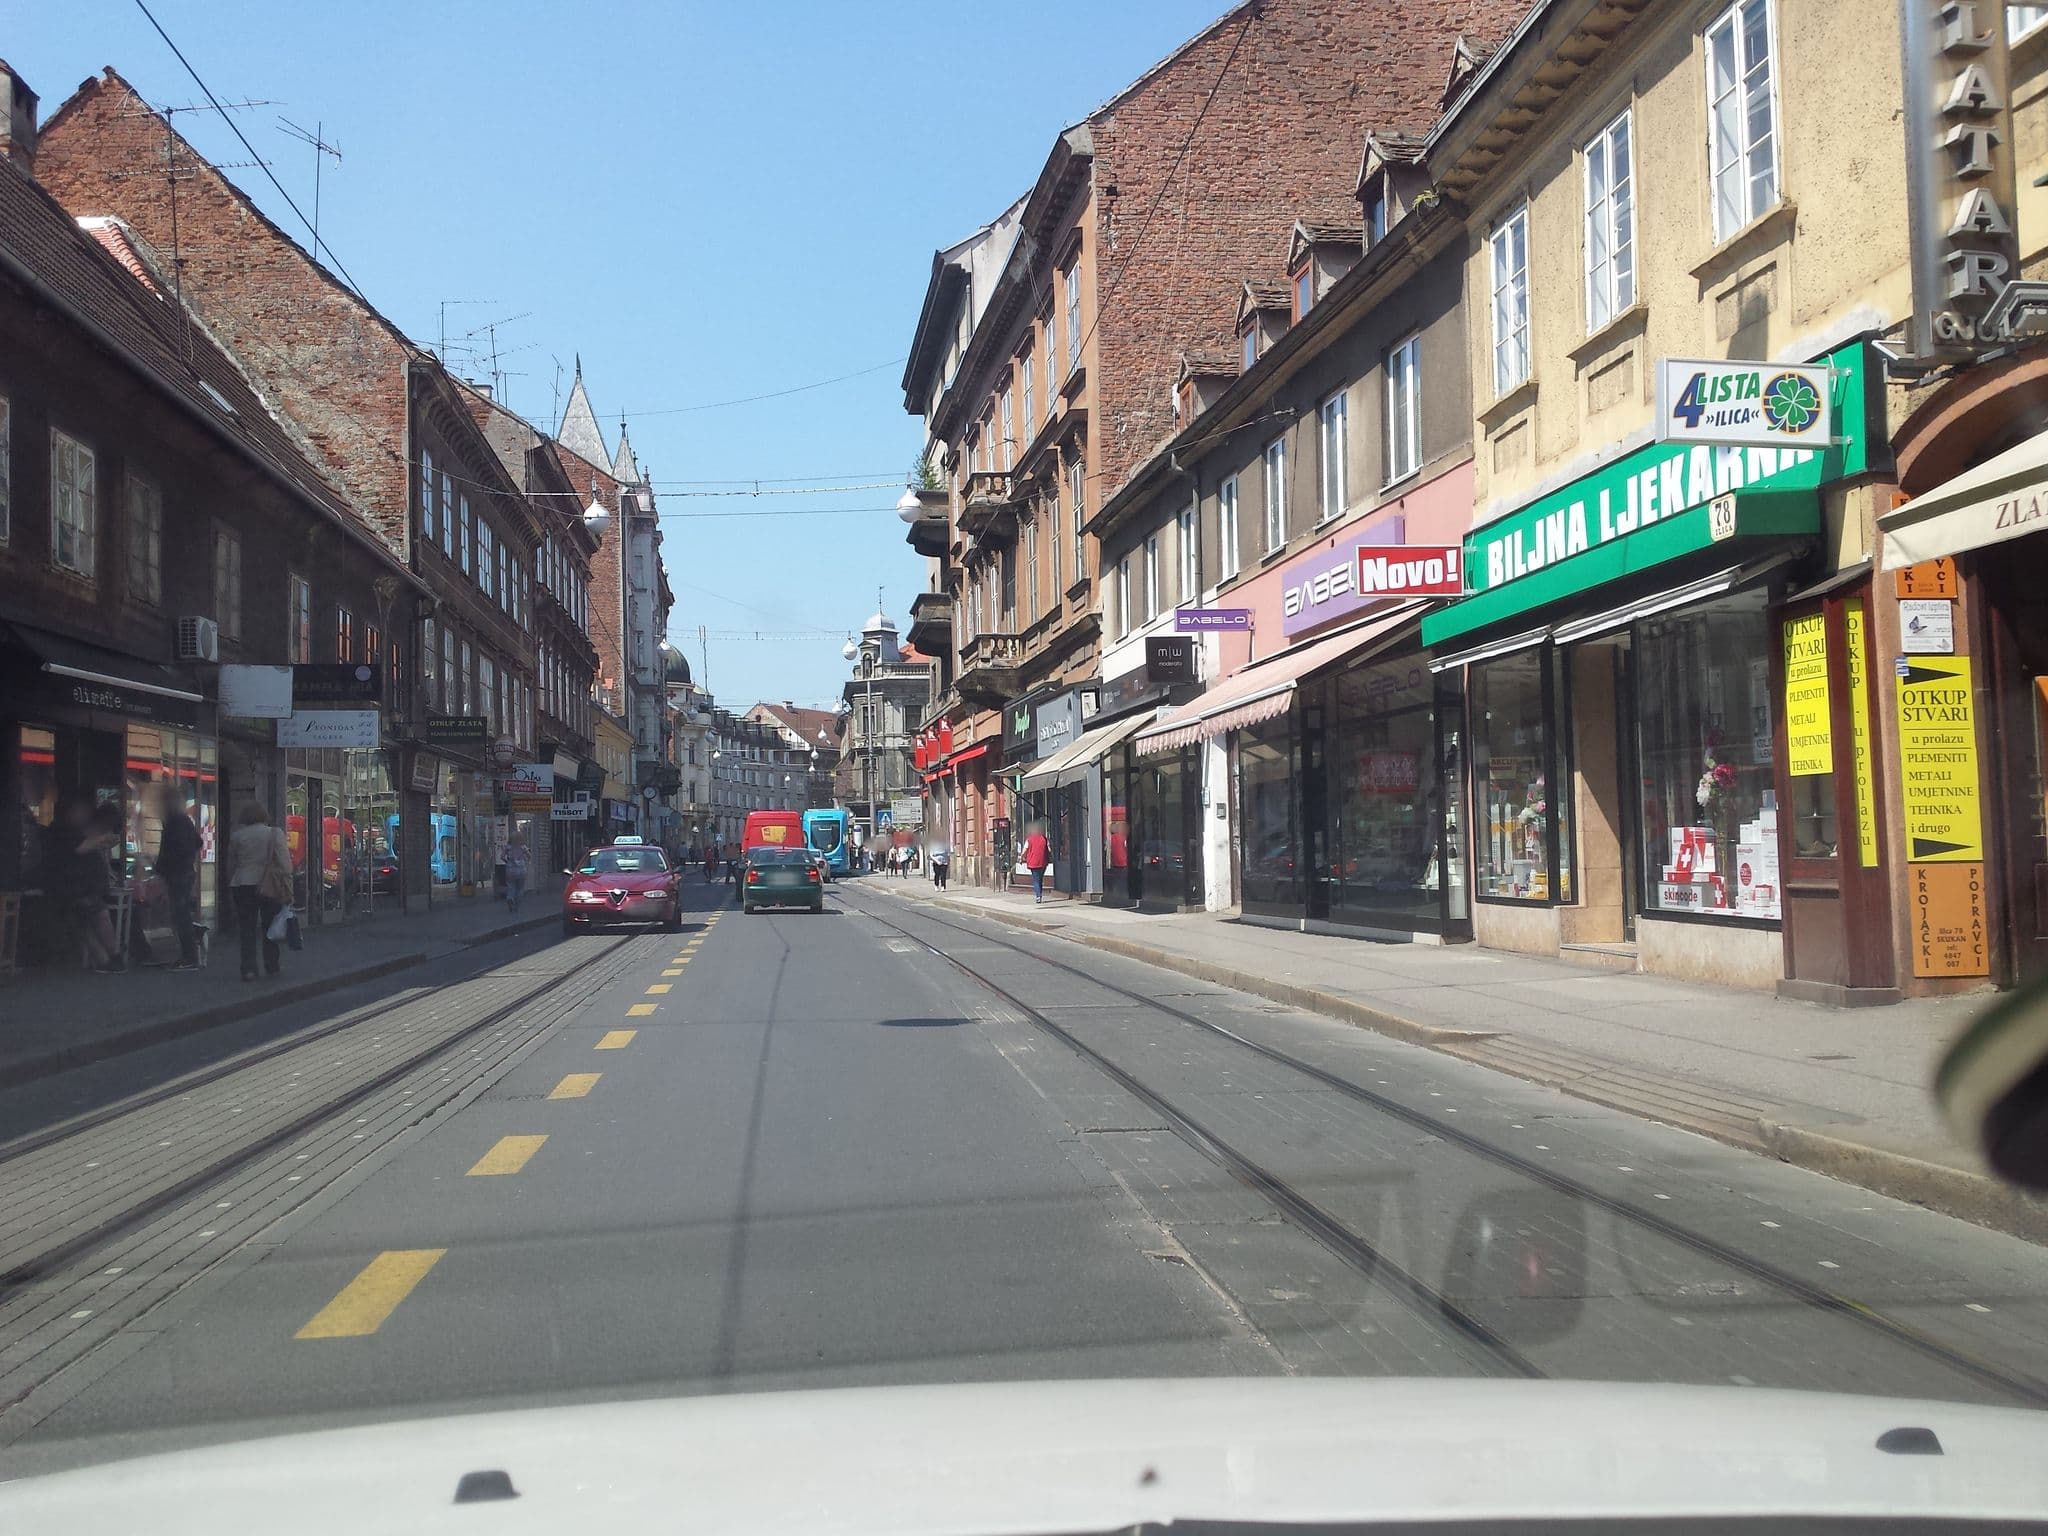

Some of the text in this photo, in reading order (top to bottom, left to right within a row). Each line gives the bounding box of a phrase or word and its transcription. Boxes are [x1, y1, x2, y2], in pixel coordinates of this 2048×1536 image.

[1715, 500, 1730, 527] 78
[1715, 524, 1733, 536] ILICA
[1487, 499, 1588, 589] BILJNA
[1362, 549, 1458, 593] Novo!
[1179, 616, 1246, 625] BABELO
[1785, 614, 1824, 638] OTKUP
[1786, 638, 1825, 661] STVARI
[1796, 664, 1822, 679] prolazu
[1789, 687, 1825, 703] PLEMENITI
[1902, 690, 1967, 706] OTKUP
[1790, 713, 1816, 726] METALI
[1903, 707, 1968, 722] STVARI
[1847, 617, 1860, 689] OTKUP
[1856, 746, 1871, 846] prolazu
[1791, 733, 1830, 748] UMJETNINE
[1912, 733, 1964, 746] u prolazu
[1792, 759, 1823, 771] TEHNIKA
[1907, 753, 1967, 763] PLEMENITI
[1909, 771, 1952, 781] METALI
[1909, 787, 1974, 798] UMJETNINE
[1909, 804, 1962, 815] TEHNIKA
[1918, 823, 1951, 834] drugo
[1664, 887, 1698, 902] skincode
[1918, 869, 1931, 968] KROJAČKI
[1969, 868, 1982, 967] POPRAVCI
